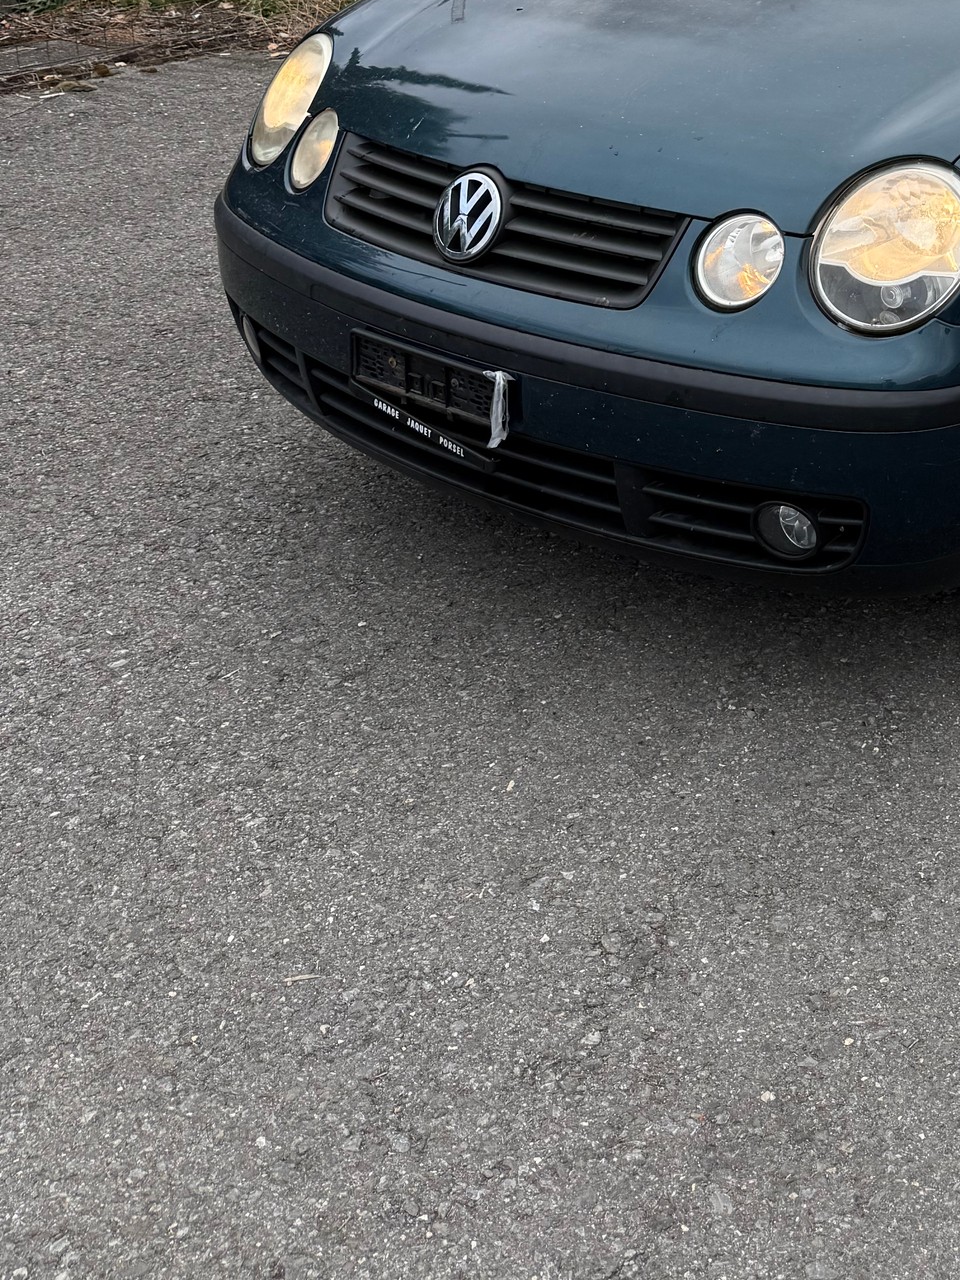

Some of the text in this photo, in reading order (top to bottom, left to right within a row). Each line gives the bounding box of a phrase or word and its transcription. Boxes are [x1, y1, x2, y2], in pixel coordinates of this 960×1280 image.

[438, 176, 497, 256] VW
[373, 399, 465, 458] GARAGE JAQUET PORSEL
